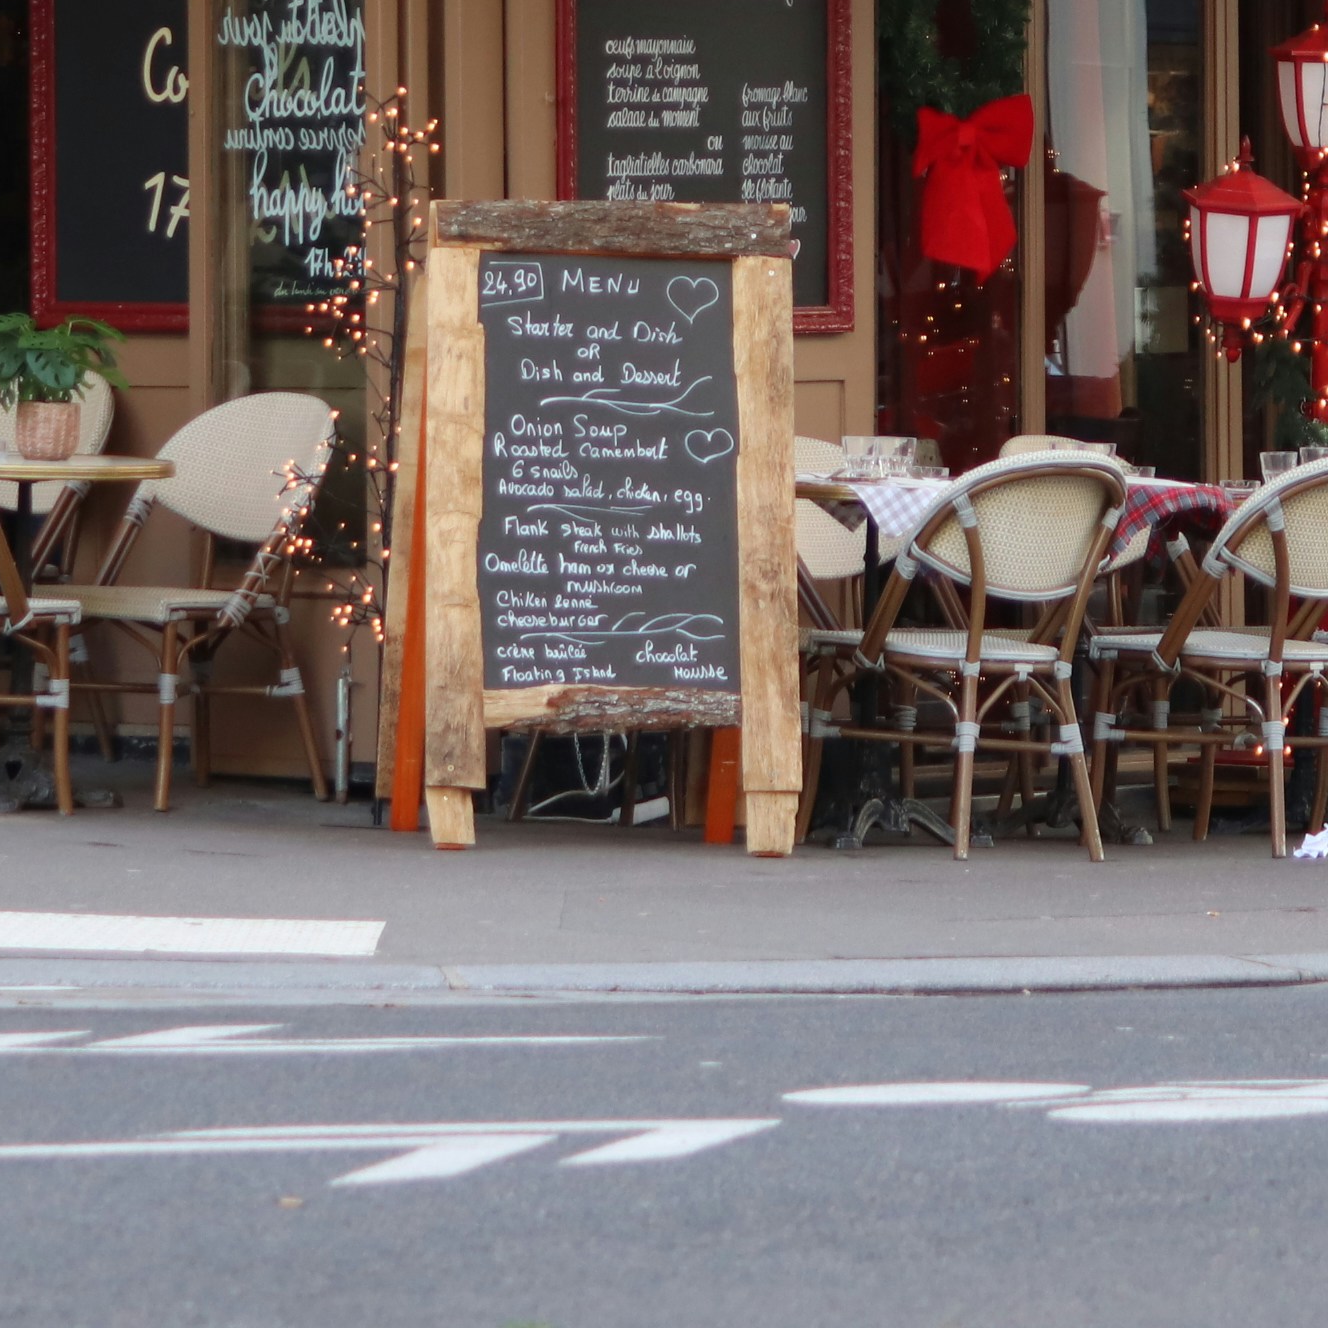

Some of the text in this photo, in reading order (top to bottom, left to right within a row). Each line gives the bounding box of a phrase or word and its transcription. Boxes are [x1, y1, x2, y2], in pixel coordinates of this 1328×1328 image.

[636, 34, 697, 62] mayonnaise
[606, 62, 643, 85] soupe
[606, 80, 710, 109] terrine de campagne
[741, 80, 808, 110] fromage blanc
[648, 112, 660, 127] du
[661, 106, 702, 127] moment
[741, 105, 793, 132] aux fruits
[707, 135, 724, 151] ou
[741, 134, 794, 151] mousse au
[671, 151, 725, 176] carbonara
[742, 152, 785, 176] chocolat
[636, 186, 648, 201] du
[649, 179, 676, 202] jour
[507, 310, 684, 345] Starter and Dish
[521, 358, 683, 387] Dish and Dessert
[510, 413, 628, 447] Onion Soup
[494, 431, 571, 459] Roasted
[512, 459, 579, 480] 6 snails
[498, 477, 555, 497] Avocado
[611, 524, 641, 540] with
[646, 521, 703, 544] shallots
[573, 538, 644, 556] French Fries
[484, 548, 550, 574] Omelette
[558, 552, 592, 575] ham
[622, 558, 669, 577] cheese
[675, 563, 697, 578] or
